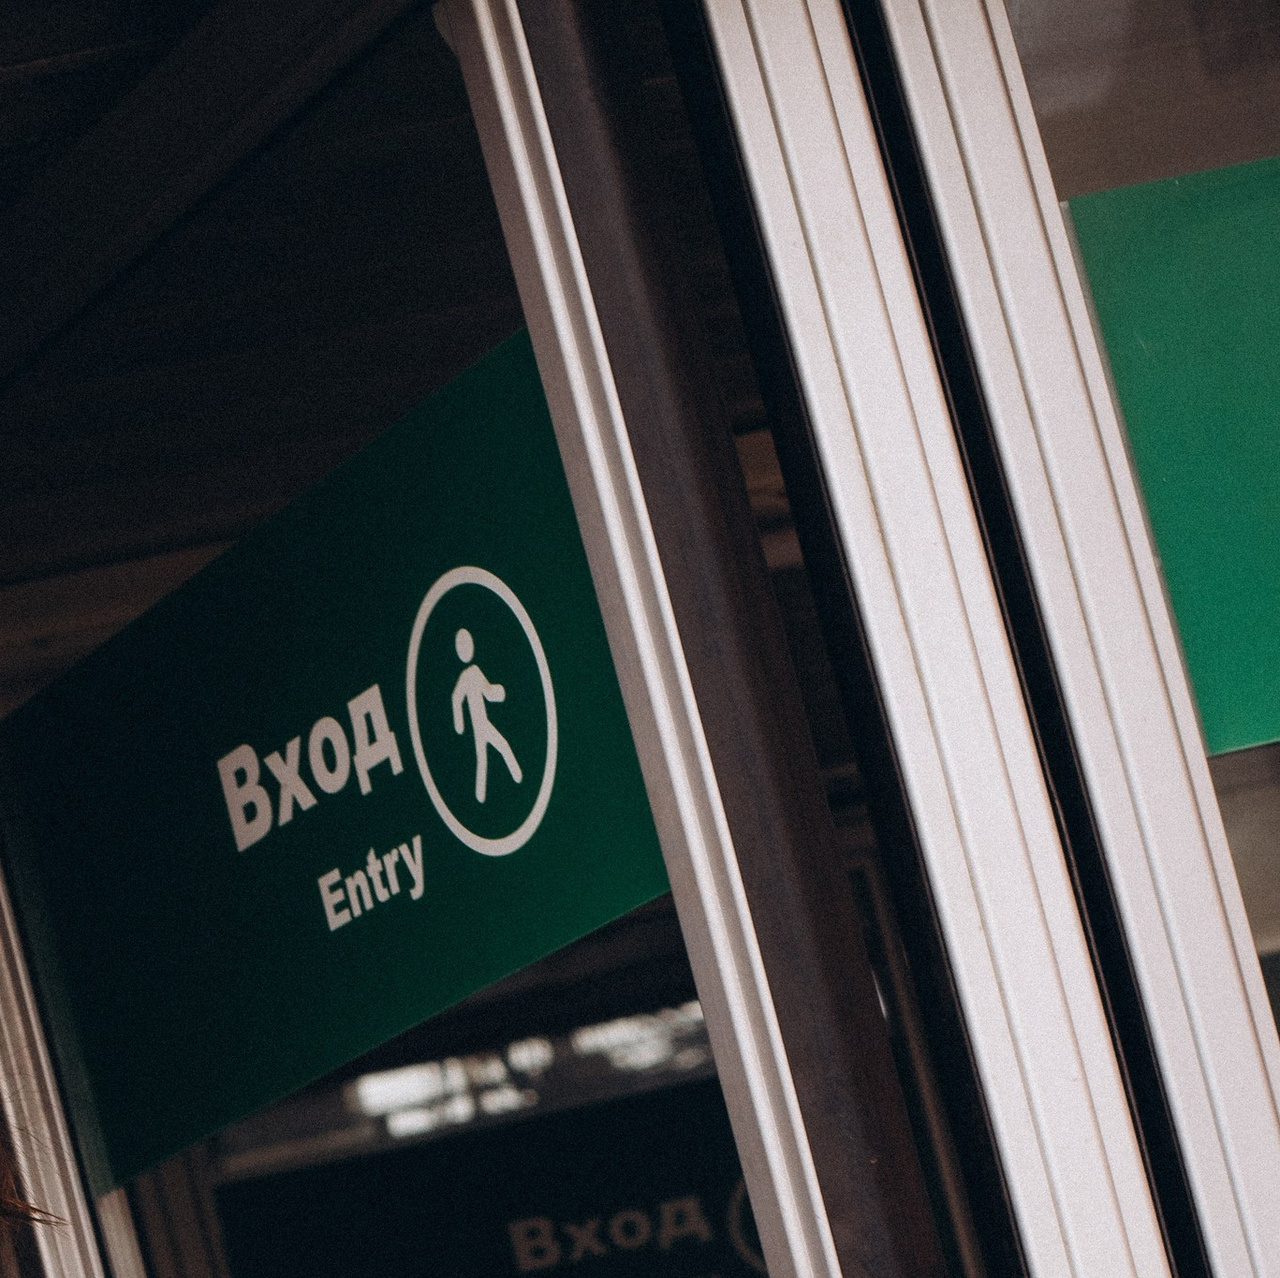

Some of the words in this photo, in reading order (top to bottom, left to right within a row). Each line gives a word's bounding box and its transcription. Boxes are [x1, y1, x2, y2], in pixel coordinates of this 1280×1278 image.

[217, 683, 404, 853] Вход
[318, 835, 424, 932] Entry
[507, 1194, 713, 1273] Вход
